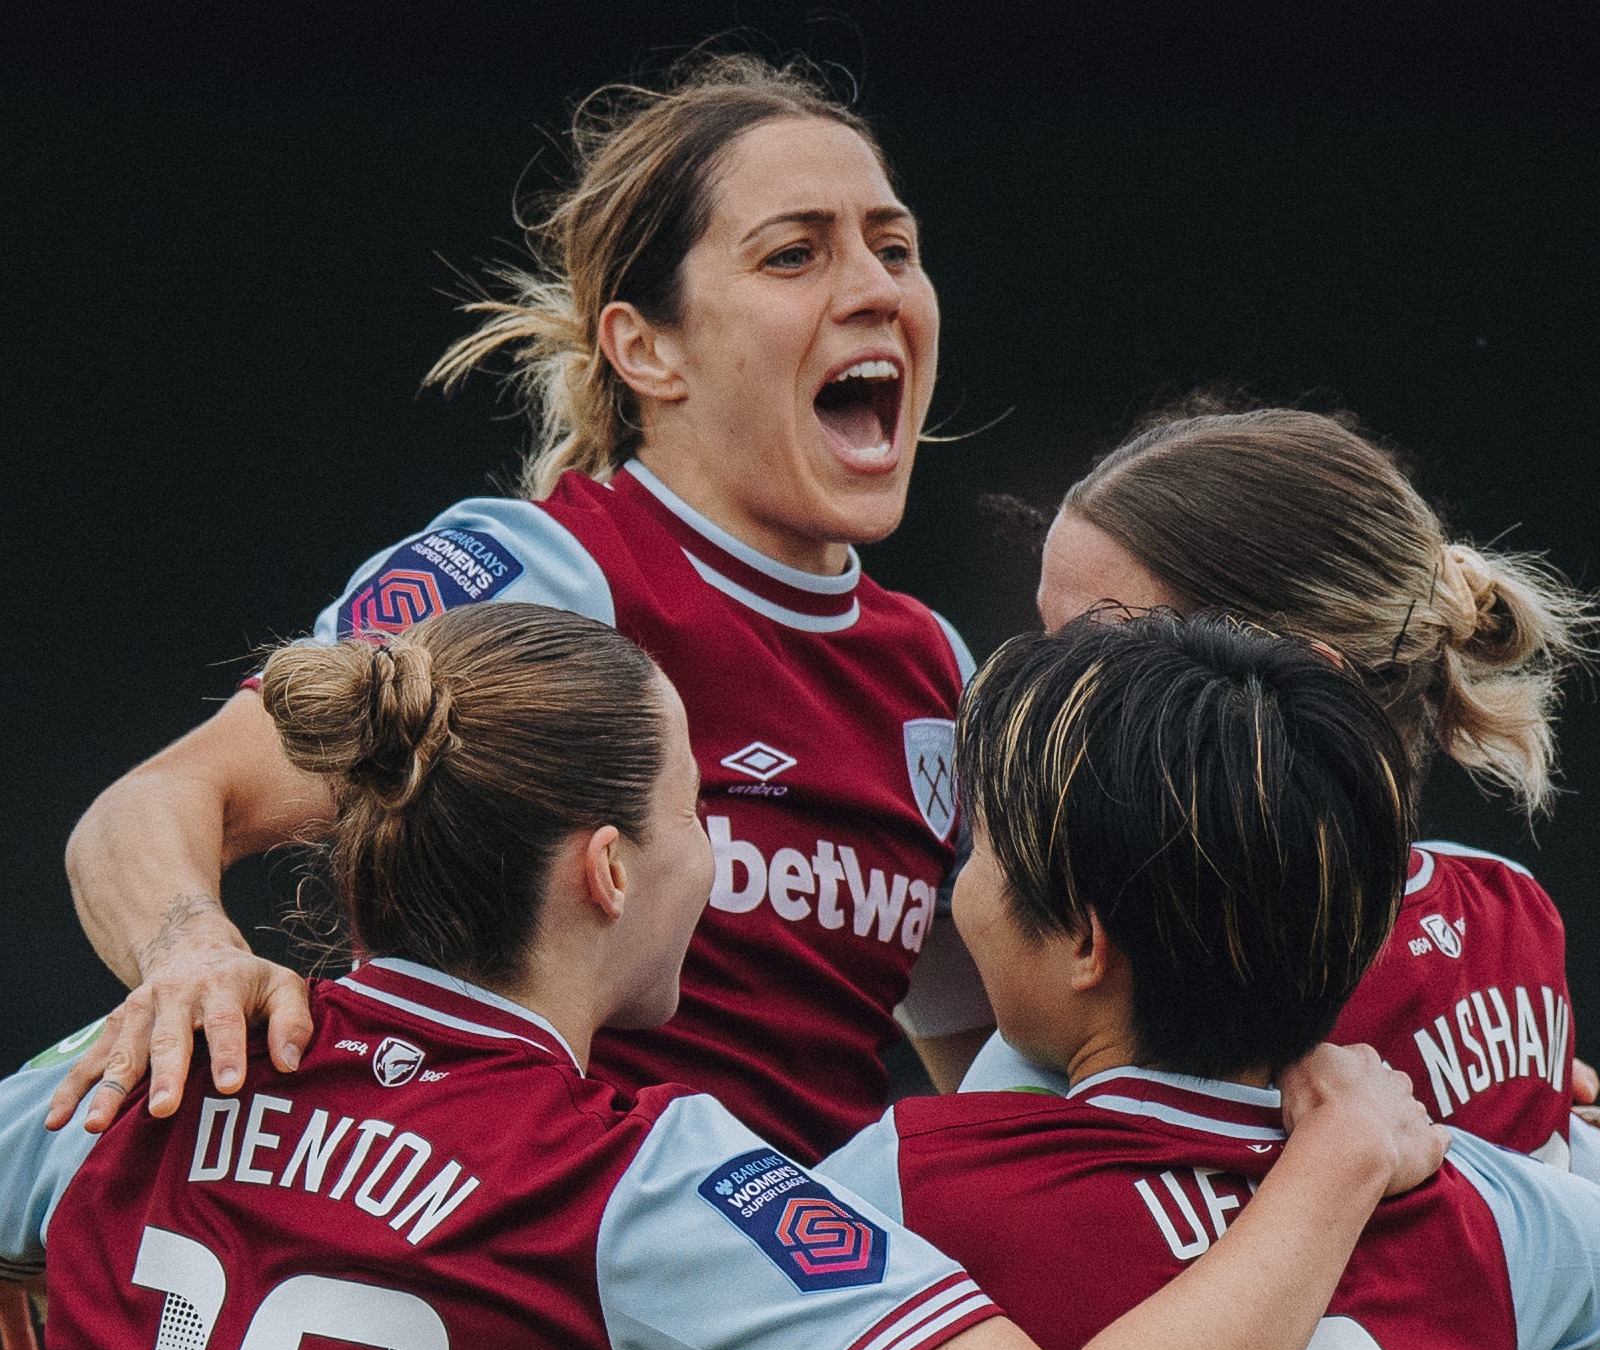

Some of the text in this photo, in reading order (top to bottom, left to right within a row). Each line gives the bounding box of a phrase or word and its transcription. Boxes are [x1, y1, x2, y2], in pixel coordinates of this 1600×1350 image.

[411, 543, 482, 599] SUPER LEAGUE
[423, 535, 494, 590] WOMEN'S
[334, 1039, 369, 1056] 1964
[187, 1092, 481, 1246] DENTON
[727, 1165, 799, 1209] WOMEN'S
[730, 1155, 784, 1185] BARCLAYS
[741, 1176, 810, 1218] SUPER LEAGUE
